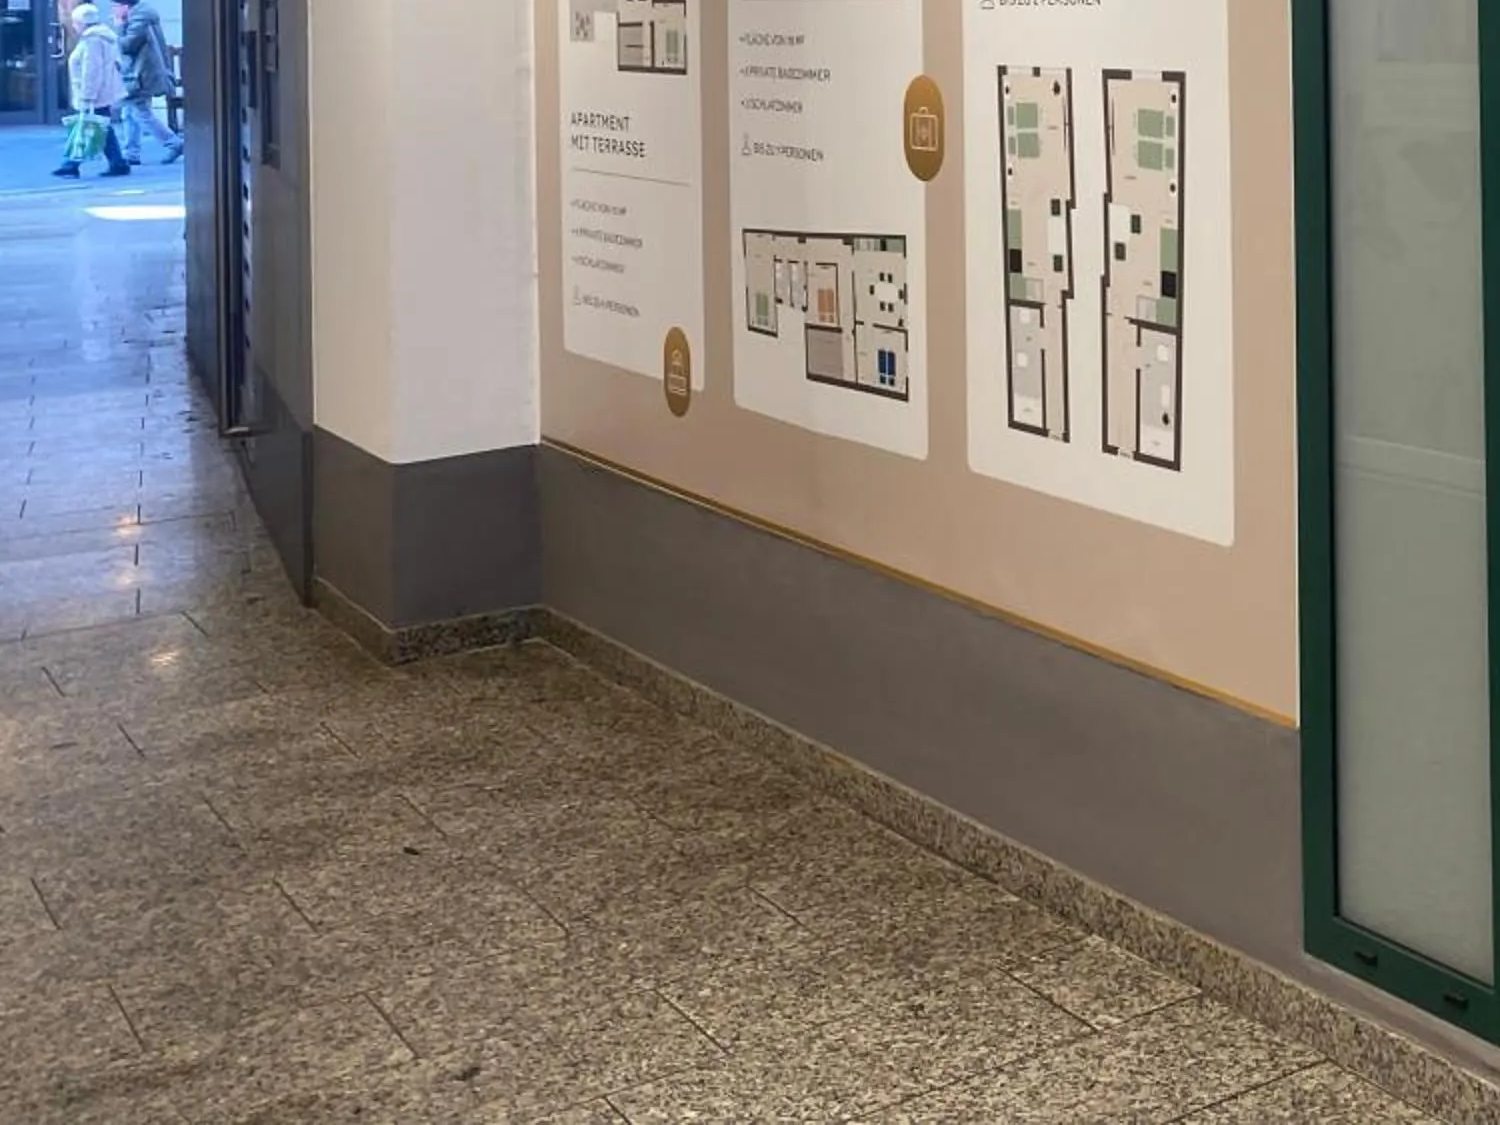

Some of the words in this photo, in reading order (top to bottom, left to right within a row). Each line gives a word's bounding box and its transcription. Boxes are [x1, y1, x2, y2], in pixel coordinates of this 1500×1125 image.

[571, 111, 630, 131] APARTMENT
[571, 134, 589, 150] MIT
[593, 136, 645, 158] TERRASSE
